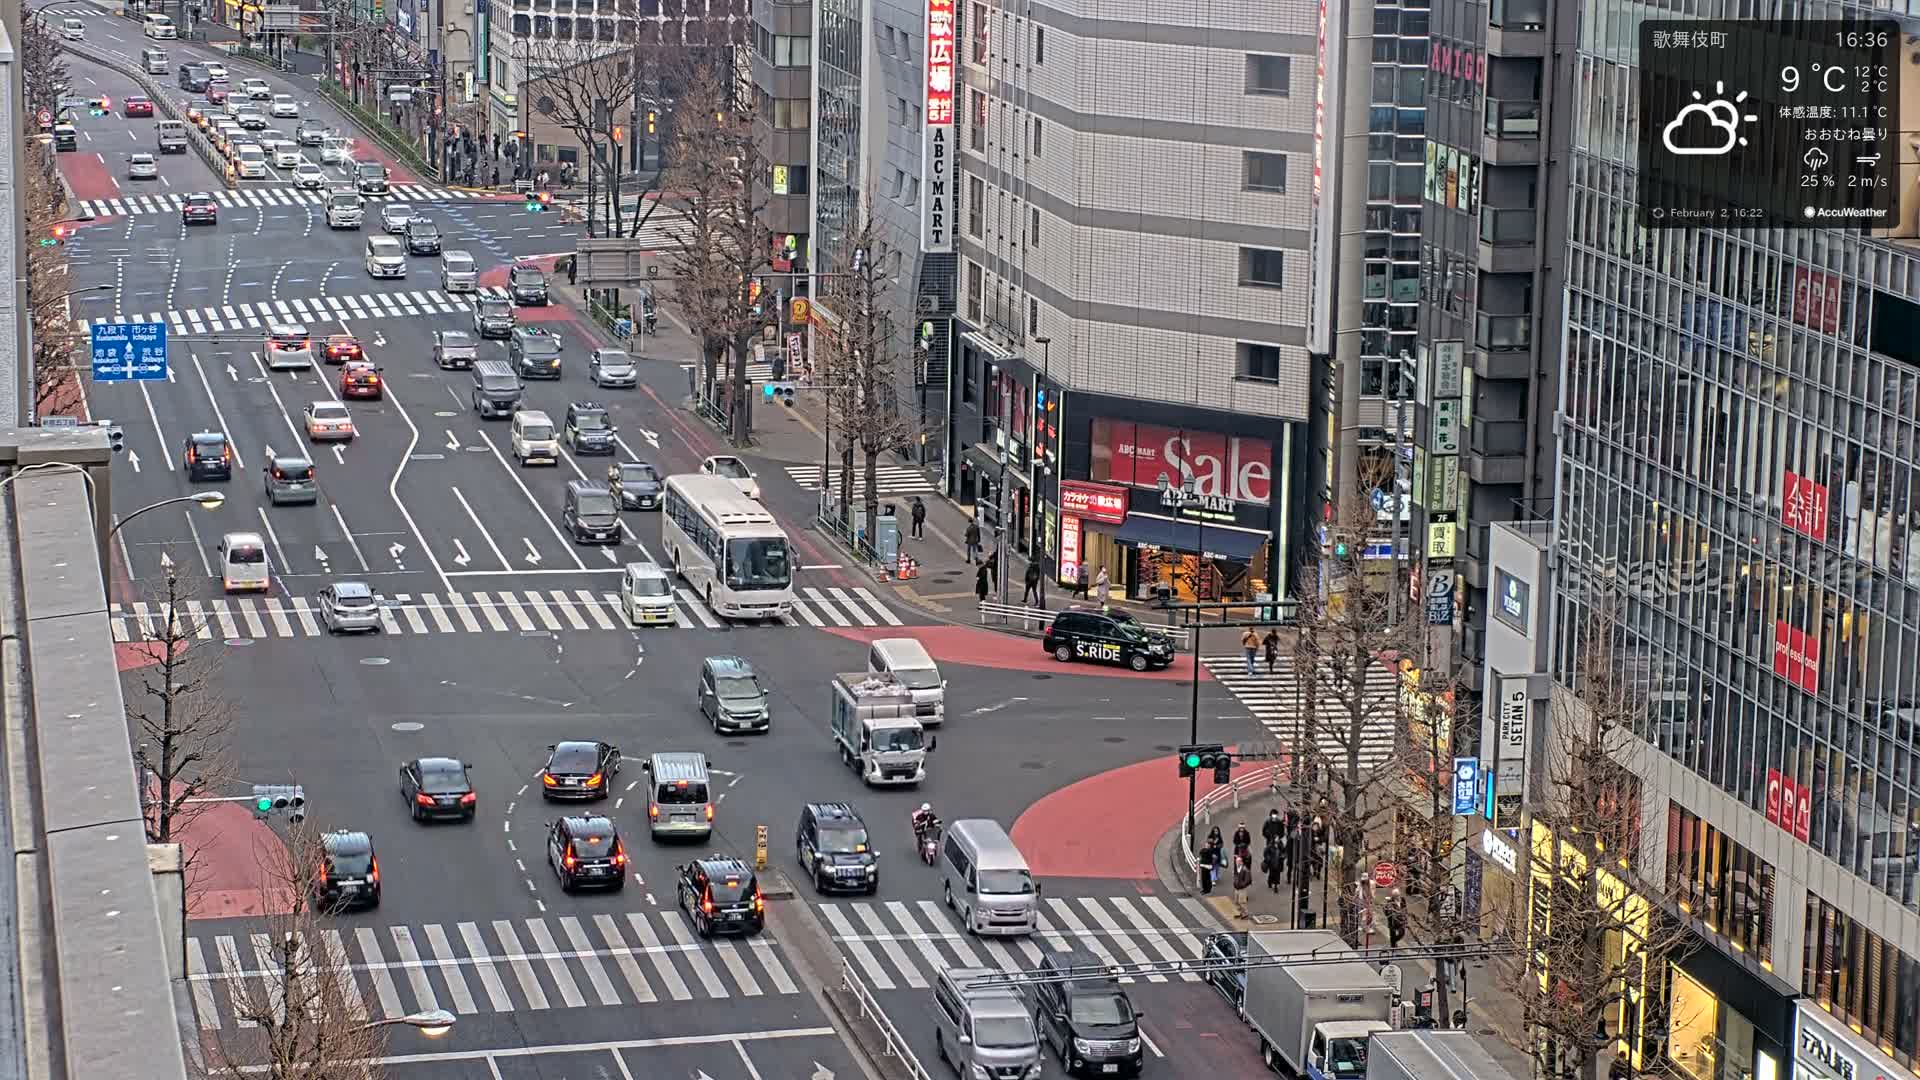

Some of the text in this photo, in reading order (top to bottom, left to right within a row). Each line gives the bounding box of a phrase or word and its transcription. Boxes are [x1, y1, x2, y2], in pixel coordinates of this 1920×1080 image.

[1431, 41, 1485, 86] AMIGO
[929, 110, 951, 121] 5F
[98, 325, 127, 335] 九段下
[1118, 443, 1155, 457] ABCMART
[1164, 436, 1271, 503] Sale
[1437, 514, 1448, 522] 7F
[1432, 526, 1446, 554] 買取
[1076, 644, 1121, 662] S.RIDE
[1776, 641, 1817, 671] professona
[1502, 702, 1511, 740] PARK CITY
[1511, 691, 1525, 746] ISETAN 5
[1769, 780, 1810, 829] CPA
